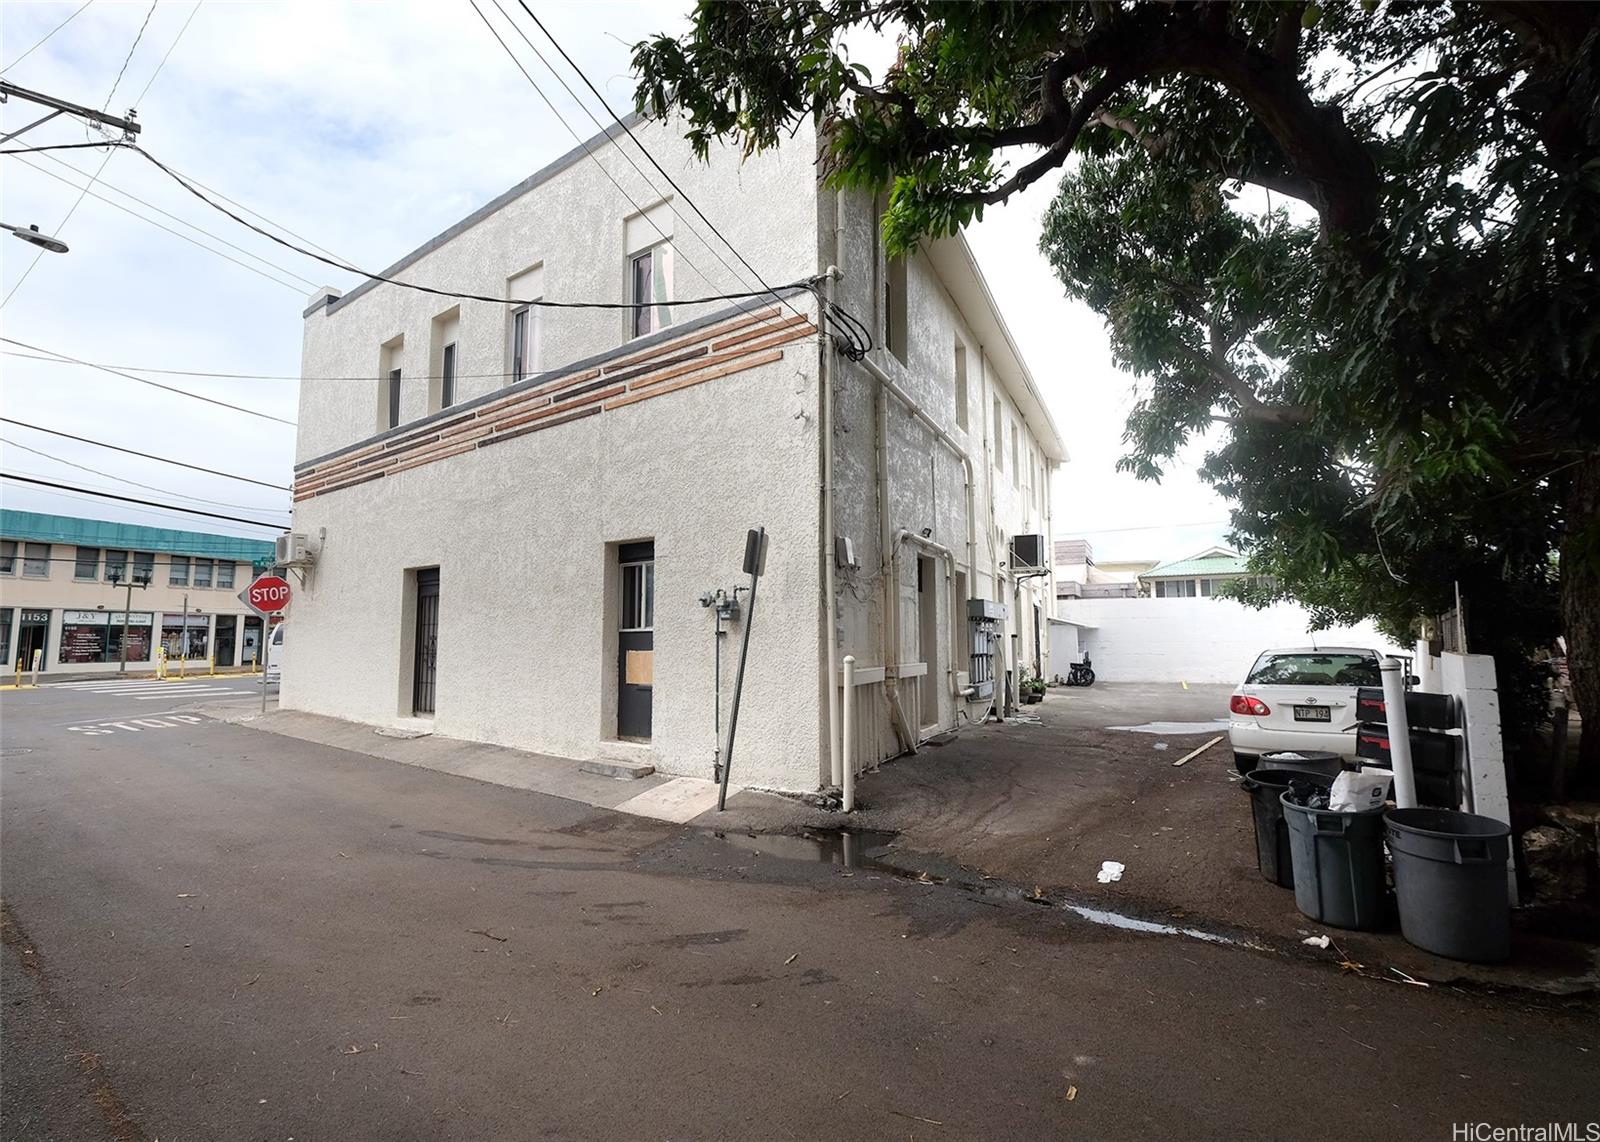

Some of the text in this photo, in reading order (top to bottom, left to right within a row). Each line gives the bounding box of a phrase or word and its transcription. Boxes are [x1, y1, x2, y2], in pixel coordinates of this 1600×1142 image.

[252, 586, 289, 603] STOP
[22, 613, 48, 621] 1153
[67, 715, 202, 735] STOP
